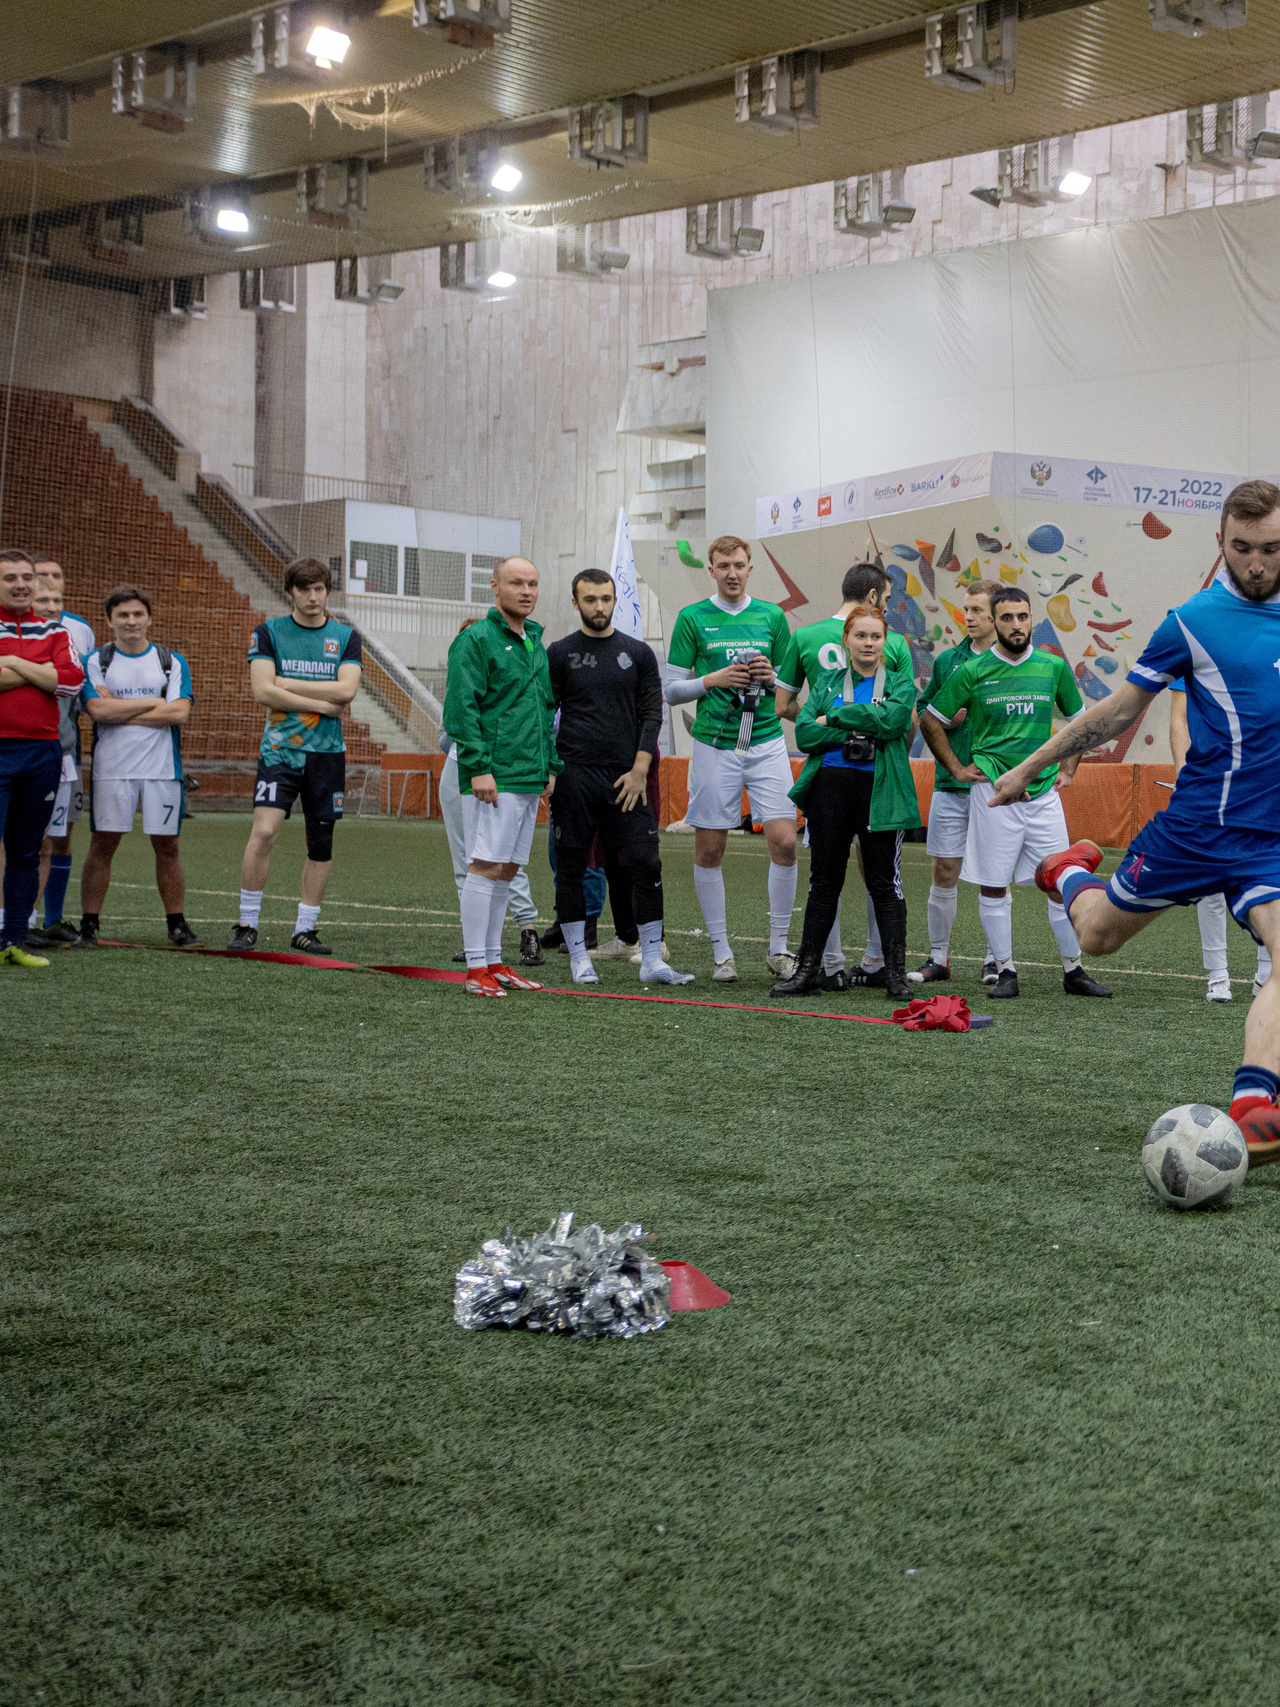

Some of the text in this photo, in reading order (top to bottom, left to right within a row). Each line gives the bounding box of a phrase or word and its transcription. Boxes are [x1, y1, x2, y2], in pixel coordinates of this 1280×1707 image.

[1179, 478, 1223, 497] 2022
[1133, 486, 1177, 507] 17-21
[1177, 500, 1222, 511] НОЯБРЯ
[707, 640, 750, 650] ДМИТРОВСКИЙ
[281, 659, 336, 674] МЕДПЛАНТ
[568, 653, 597, 669] 24
[986, 694, 1050, 704] ДМИТРОВСКИЙ ЗАВОД
[1006, 702, 1034, 715] РТИ
[256, 780, 278, 802] 21
[162, 804, 174, 825] 7
